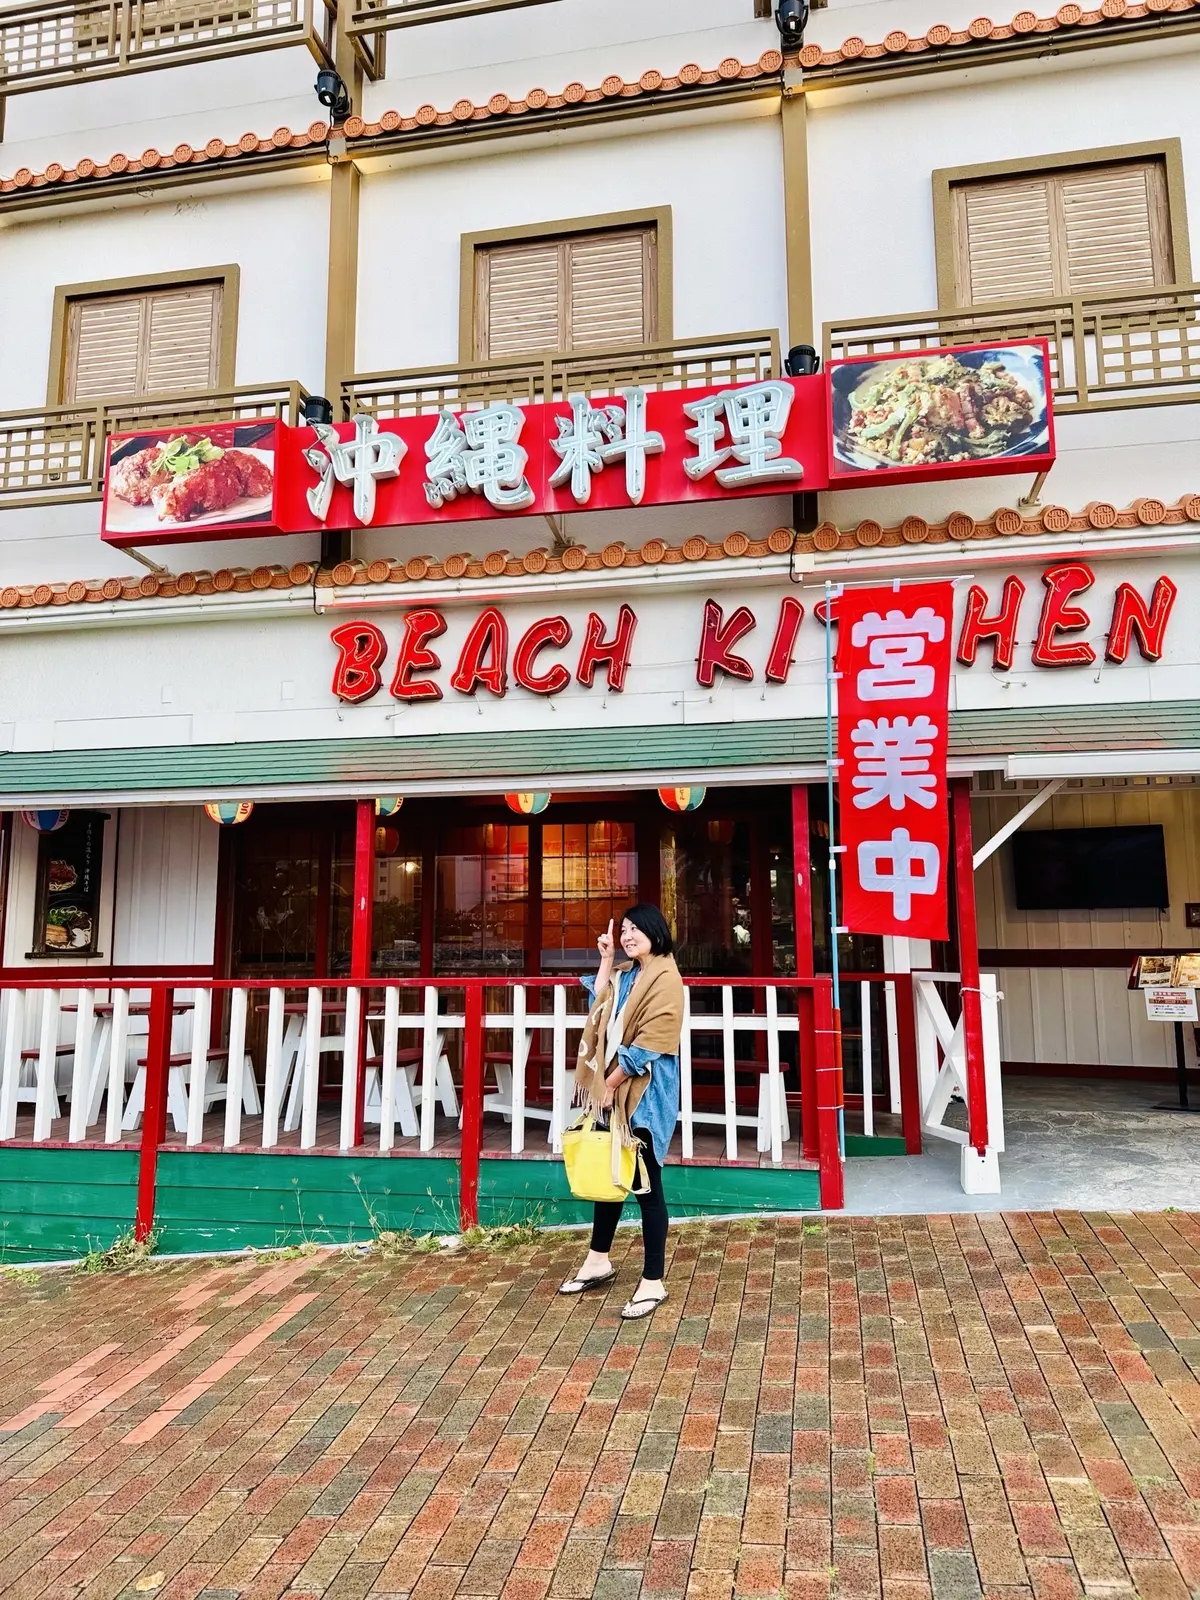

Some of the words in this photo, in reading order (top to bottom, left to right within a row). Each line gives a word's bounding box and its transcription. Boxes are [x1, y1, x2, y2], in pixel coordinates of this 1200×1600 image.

[302, 380, 804, 526] 沖縄料理
[330, 603, 638, 703] BEACH
[696, 563, 1178, 688] KIHEN
[850, 605, 946, 922] 営業中
